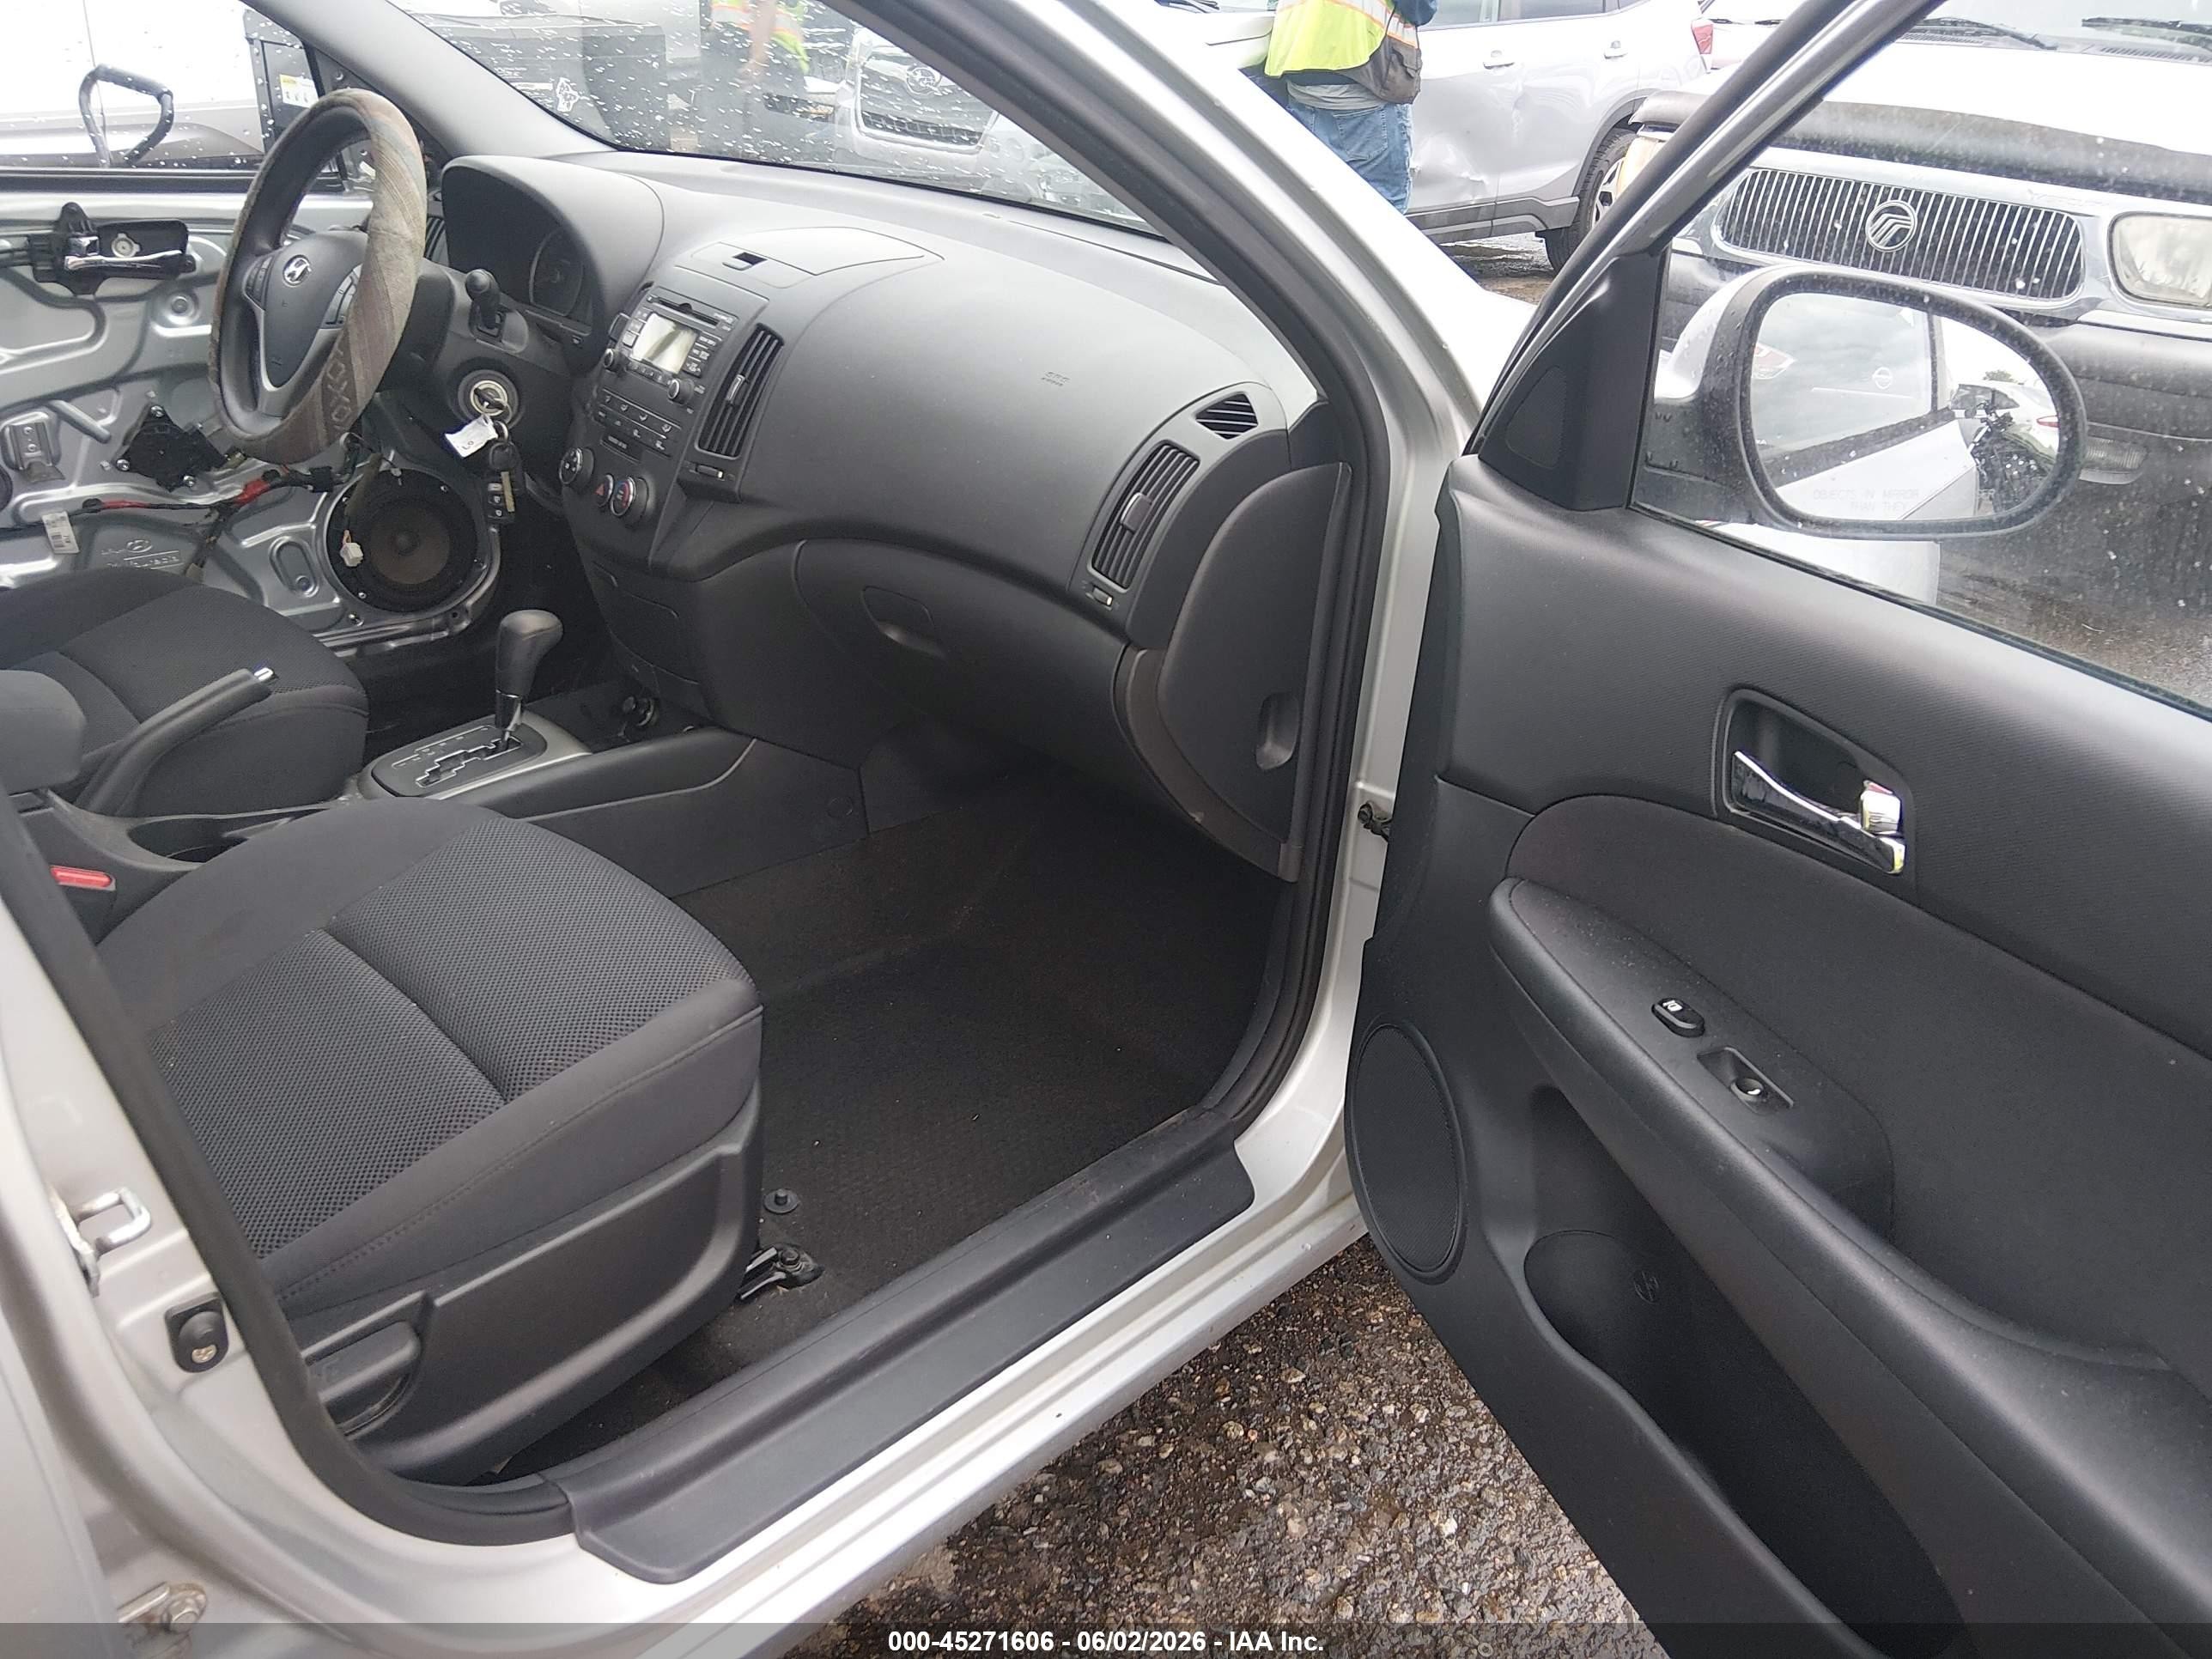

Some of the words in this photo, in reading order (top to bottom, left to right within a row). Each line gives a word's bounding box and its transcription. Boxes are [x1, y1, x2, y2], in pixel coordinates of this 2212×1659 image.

[1813, 489, 1856, 500] OBJECTS
[1881, 489, 1919, 500] MIRROR
[1850, 501, 1875, 512] THAN
